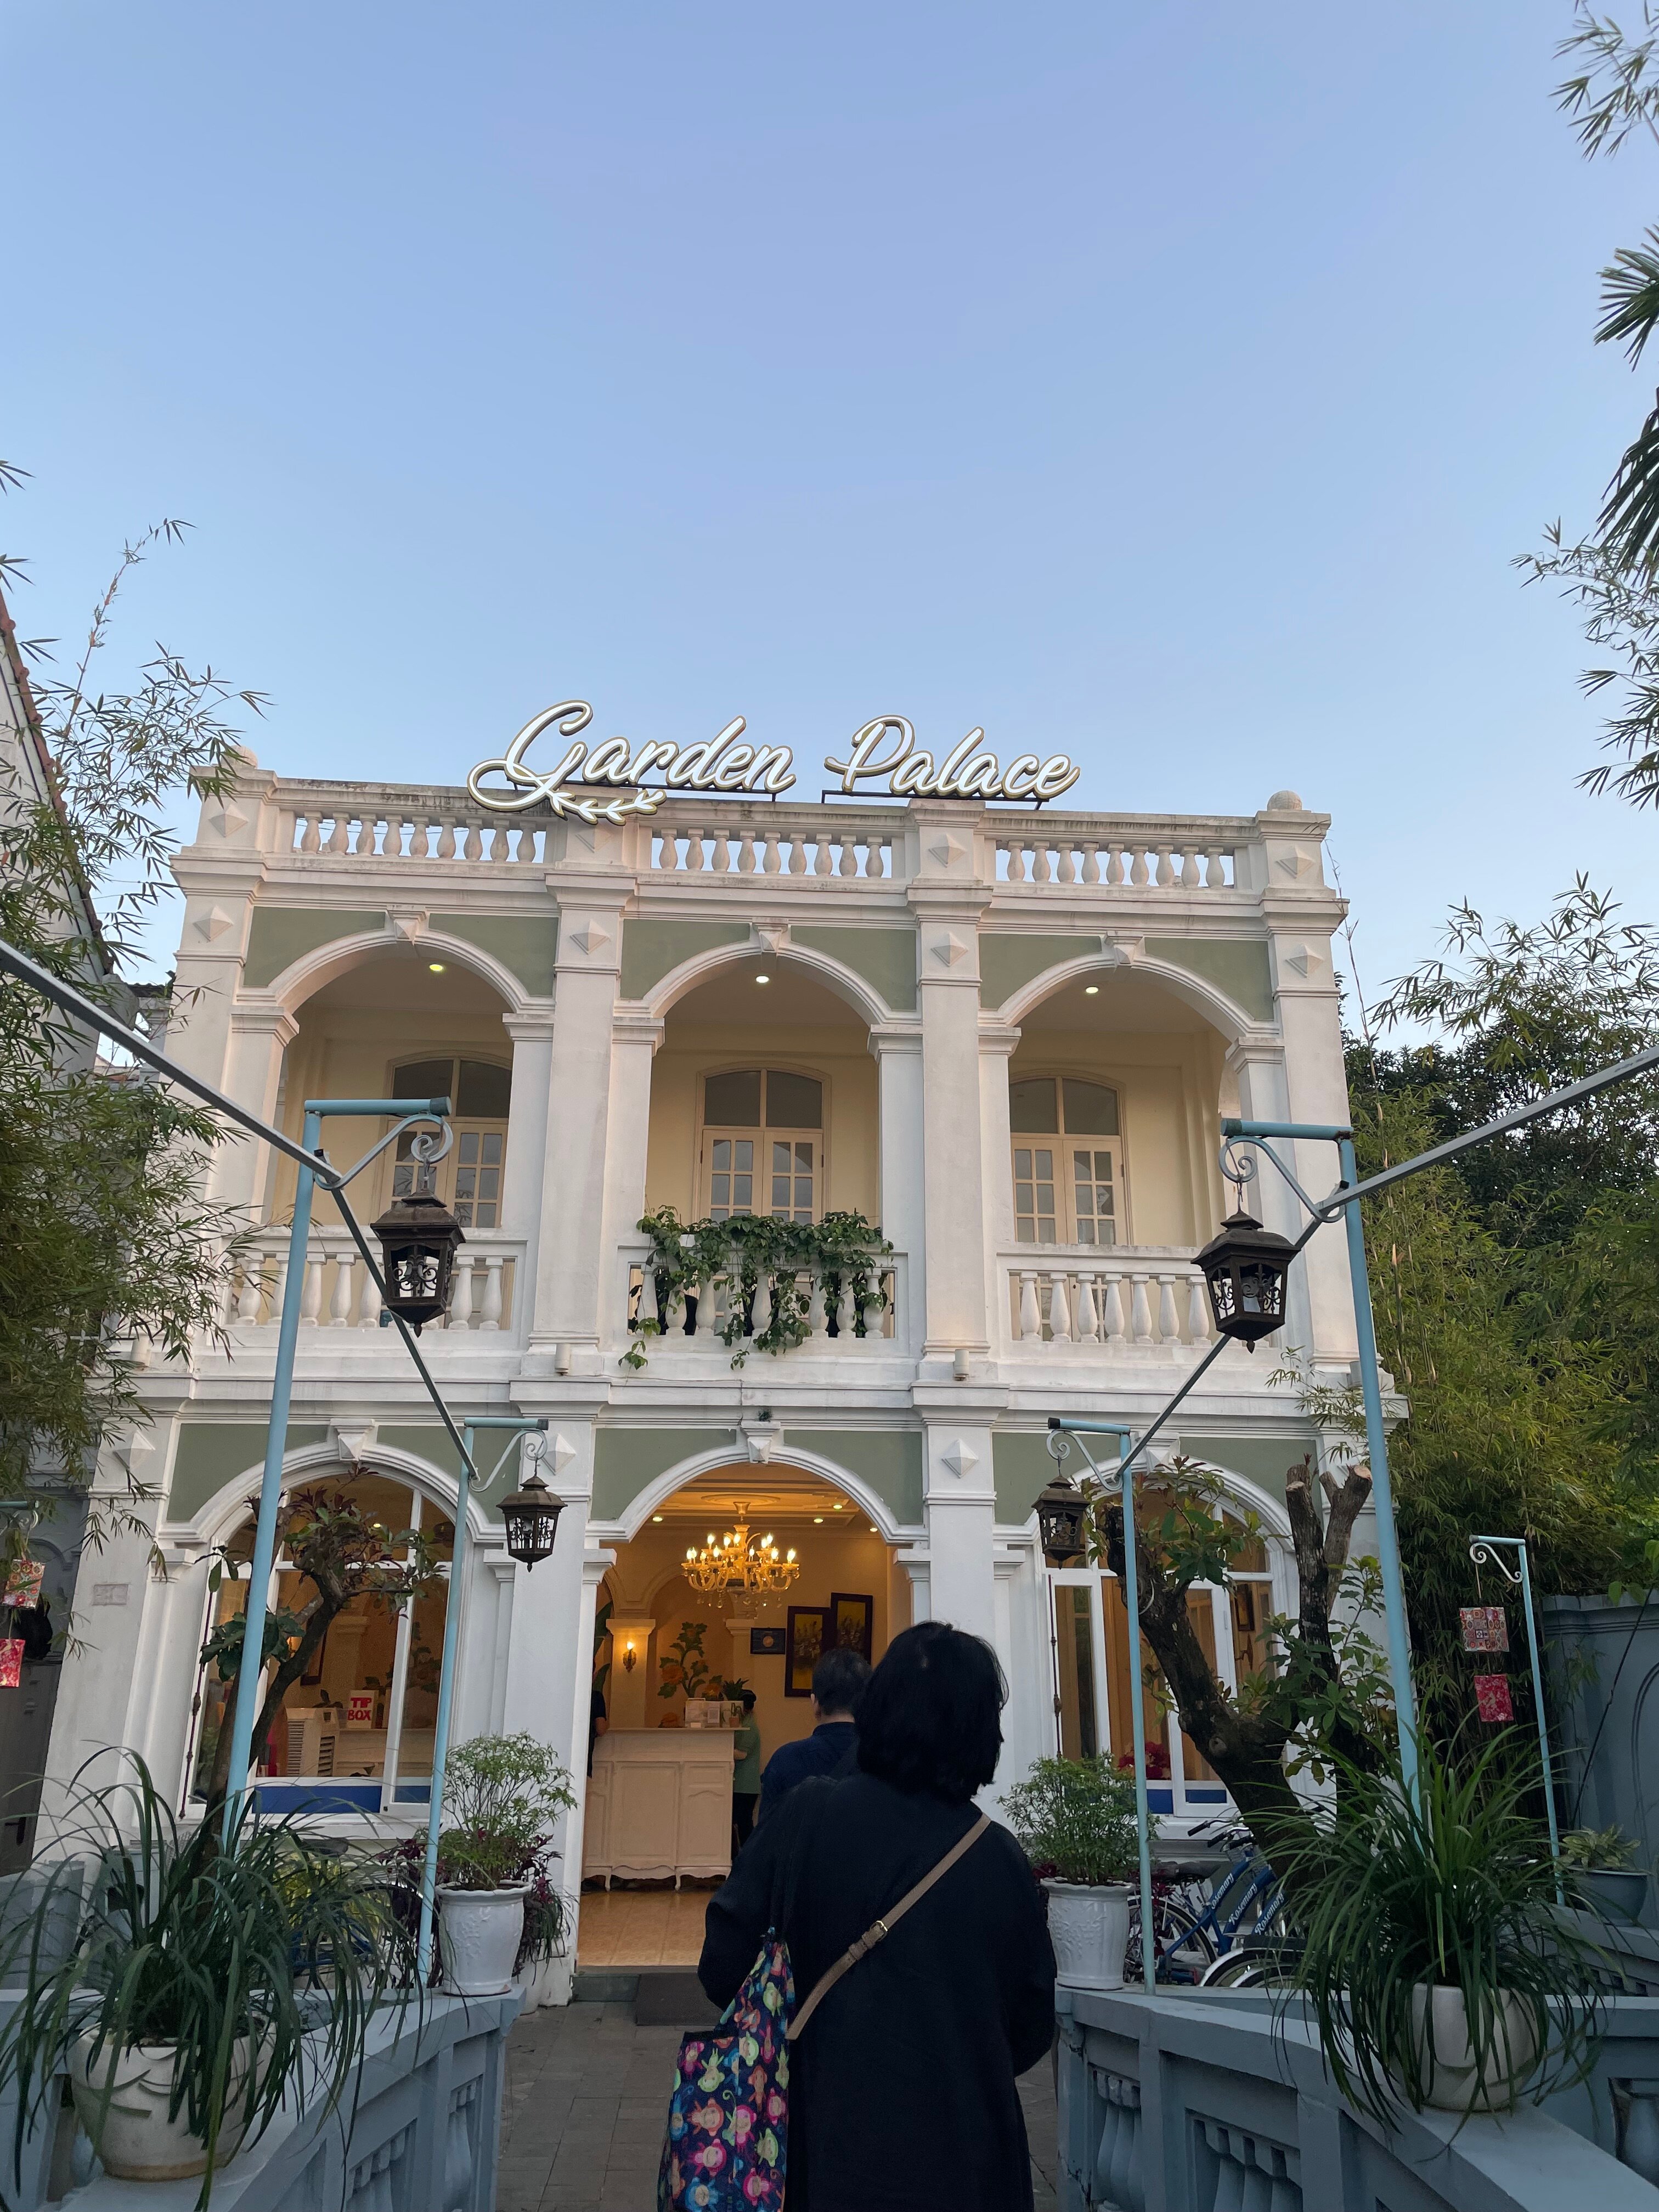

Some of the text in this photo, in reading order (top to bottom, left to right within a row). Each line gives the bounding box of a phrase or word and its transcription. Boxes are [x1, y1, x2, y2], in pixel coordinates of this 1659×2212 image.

[467, 699, 1081, 813] Garden Palace
[348, 1709, 371, 1720] BOX
[351, 1697, 372, 1708] TIP
[1211, 1873, 1234, 1909] osemary
[1255, 1893, 1284, 1935] Rosemary
